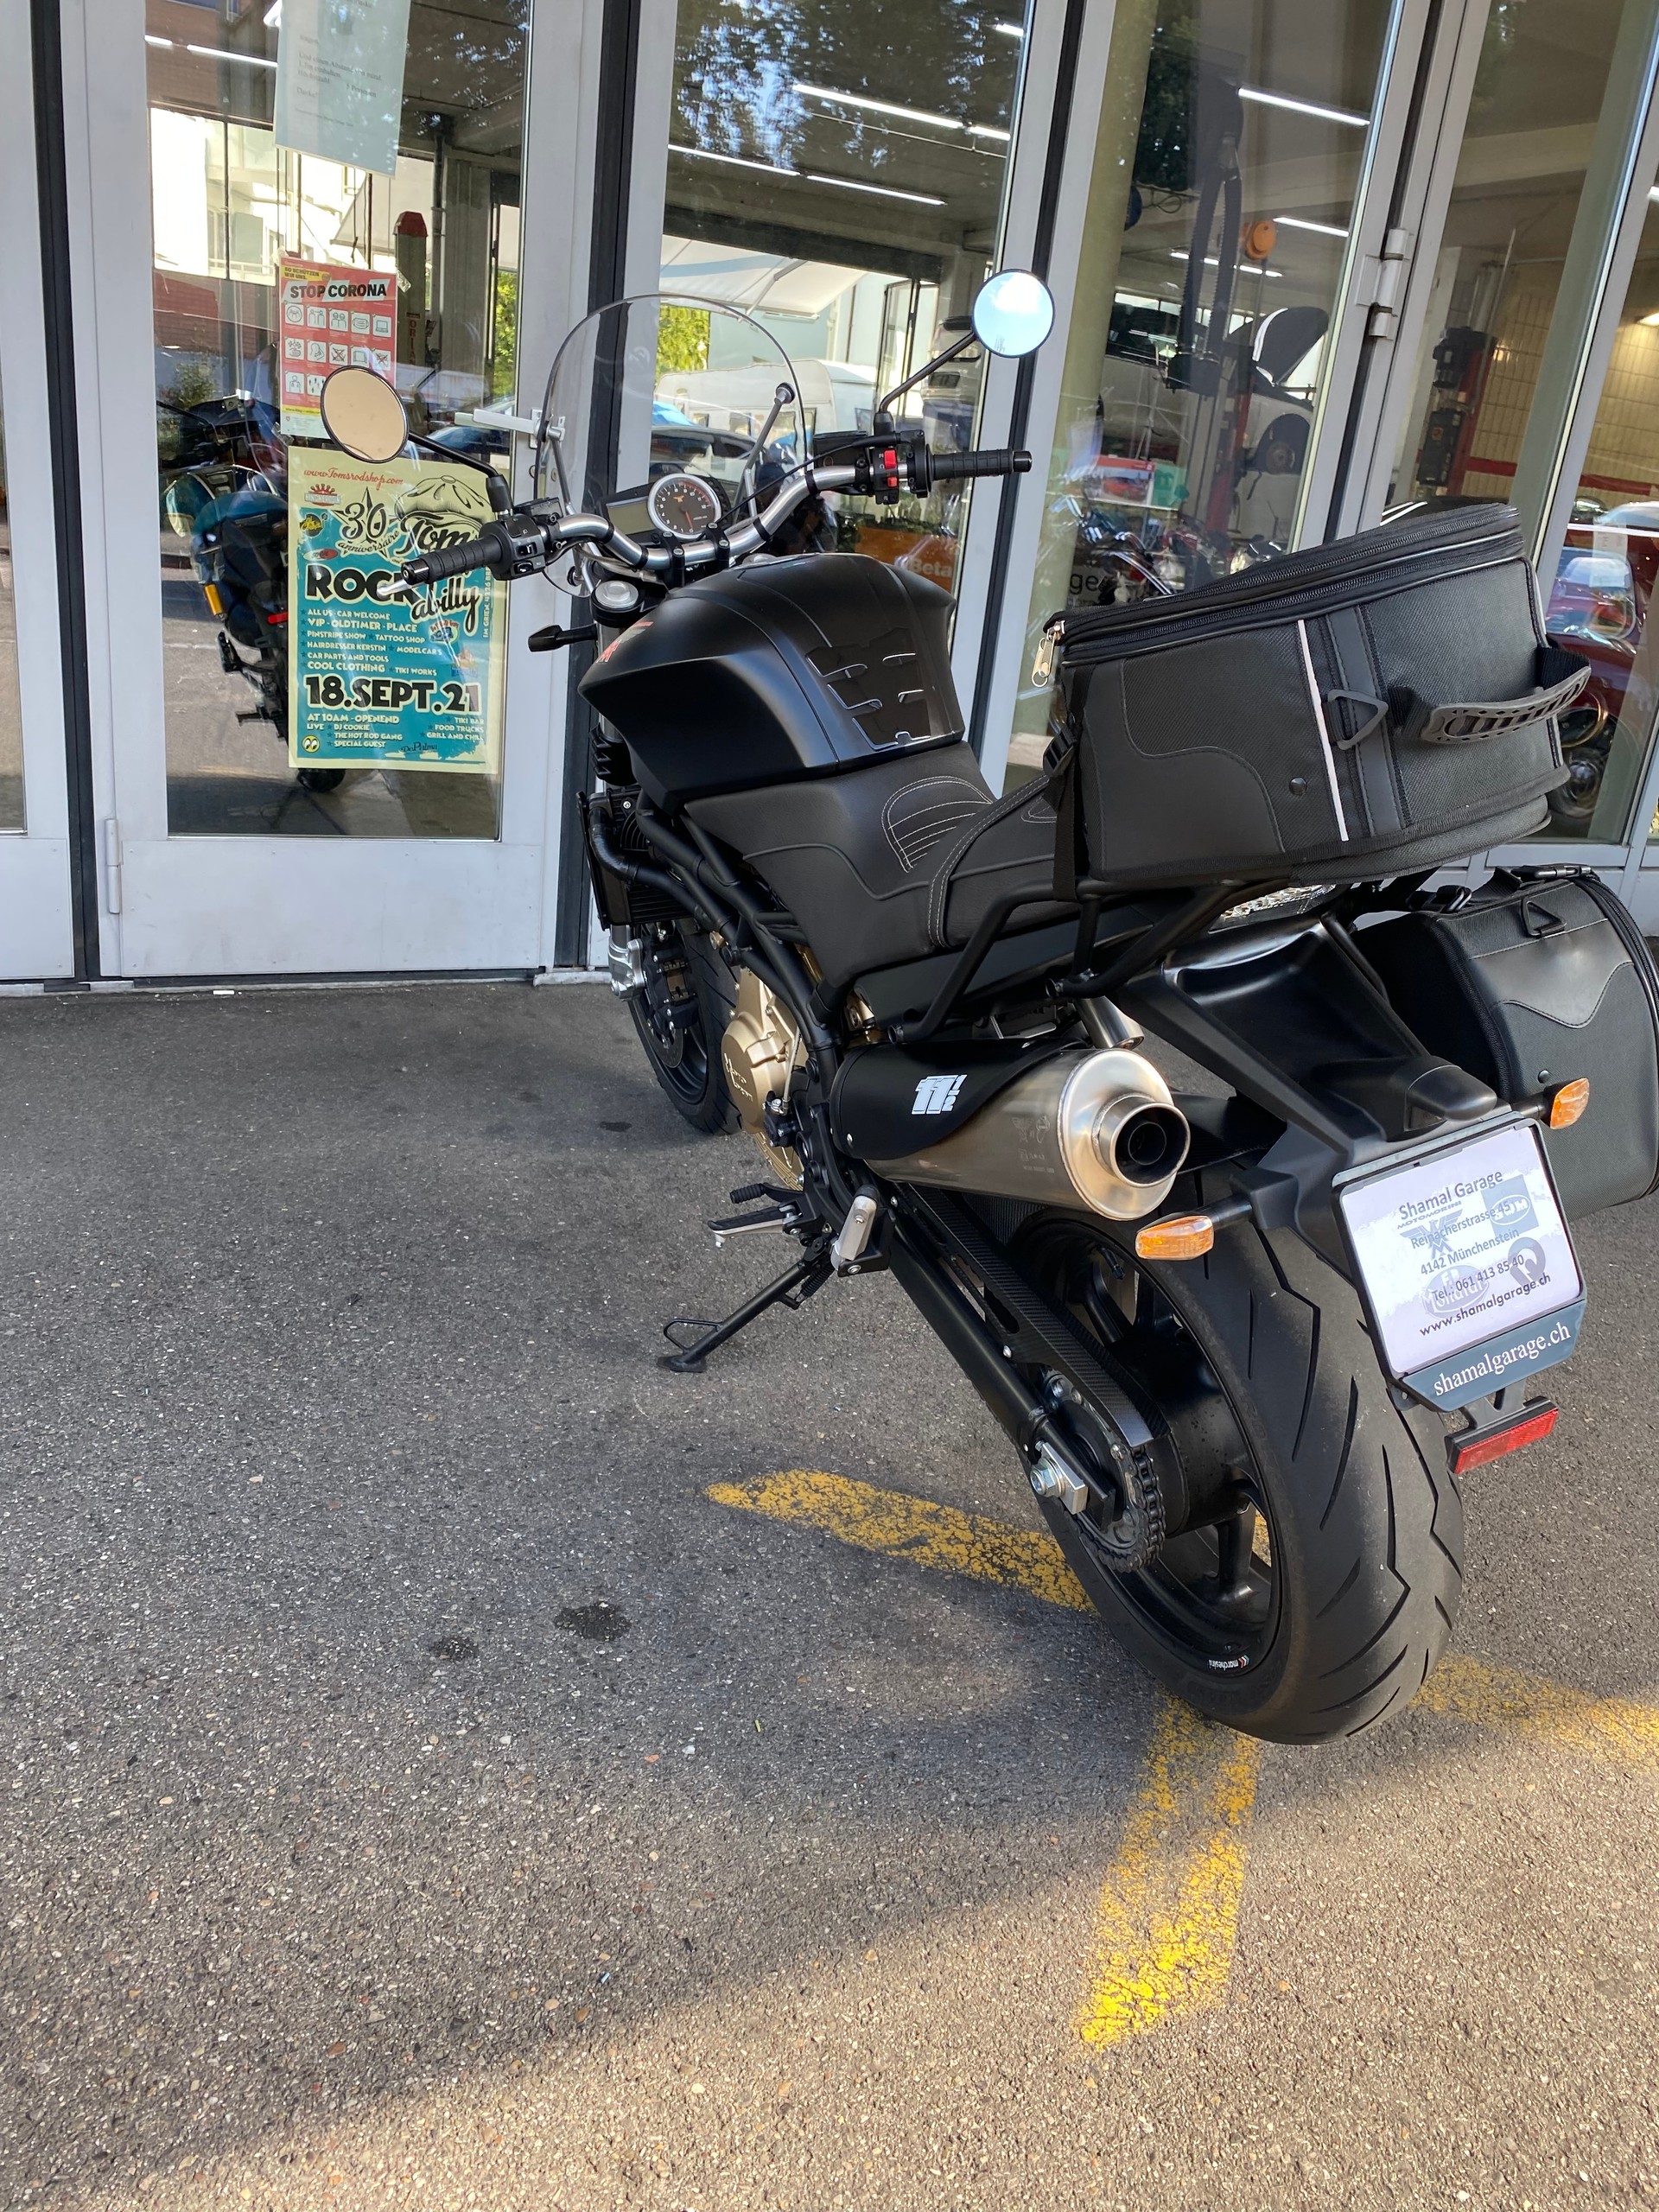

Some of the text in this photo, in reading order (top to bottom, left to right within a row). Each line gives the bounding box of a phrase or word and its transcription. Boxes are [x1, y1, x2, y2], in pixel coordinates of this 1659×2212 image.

[290, 284, 386, 298] STOP CORONA
[342, 502, 386, 539] 30
[396, 512, 479, 554] Tom'
[338, 530, 399, 552] anniversaire
[910, 558, 952, 577] Beta
[307, 630, 343, 639] PINSTRIPE
[308, 618, 325, 626] VIP
[331, 620, 381, 630] OLDTIMER
[386, 622, 417, 632] PLACE
[307, 641, 355, 650] HAIRDRESSER
[307, 661, 385, 672] COOL CLOTHING
[321, 714, 349, 722] 10AM
[1399, 1172, 1503, 1220] Shamal Garage
[1411, 1200, 1510, 1249] Reinacherstrasse 45
[1421, 1228, 1521, 1275] 4142 Münchenstein
[1456, 1275, 1476, 1291] 061
[1477, 1267, 1496, 1281] 413
[1497, 1261, 1510, 1274] 85
[1512, 1255, 1524, 1268] 40
[1420, 1273, 1551, 1336] www.shamalgarage.ch
[1433, 1322, 1571, 1396] shamalgarage.ch
